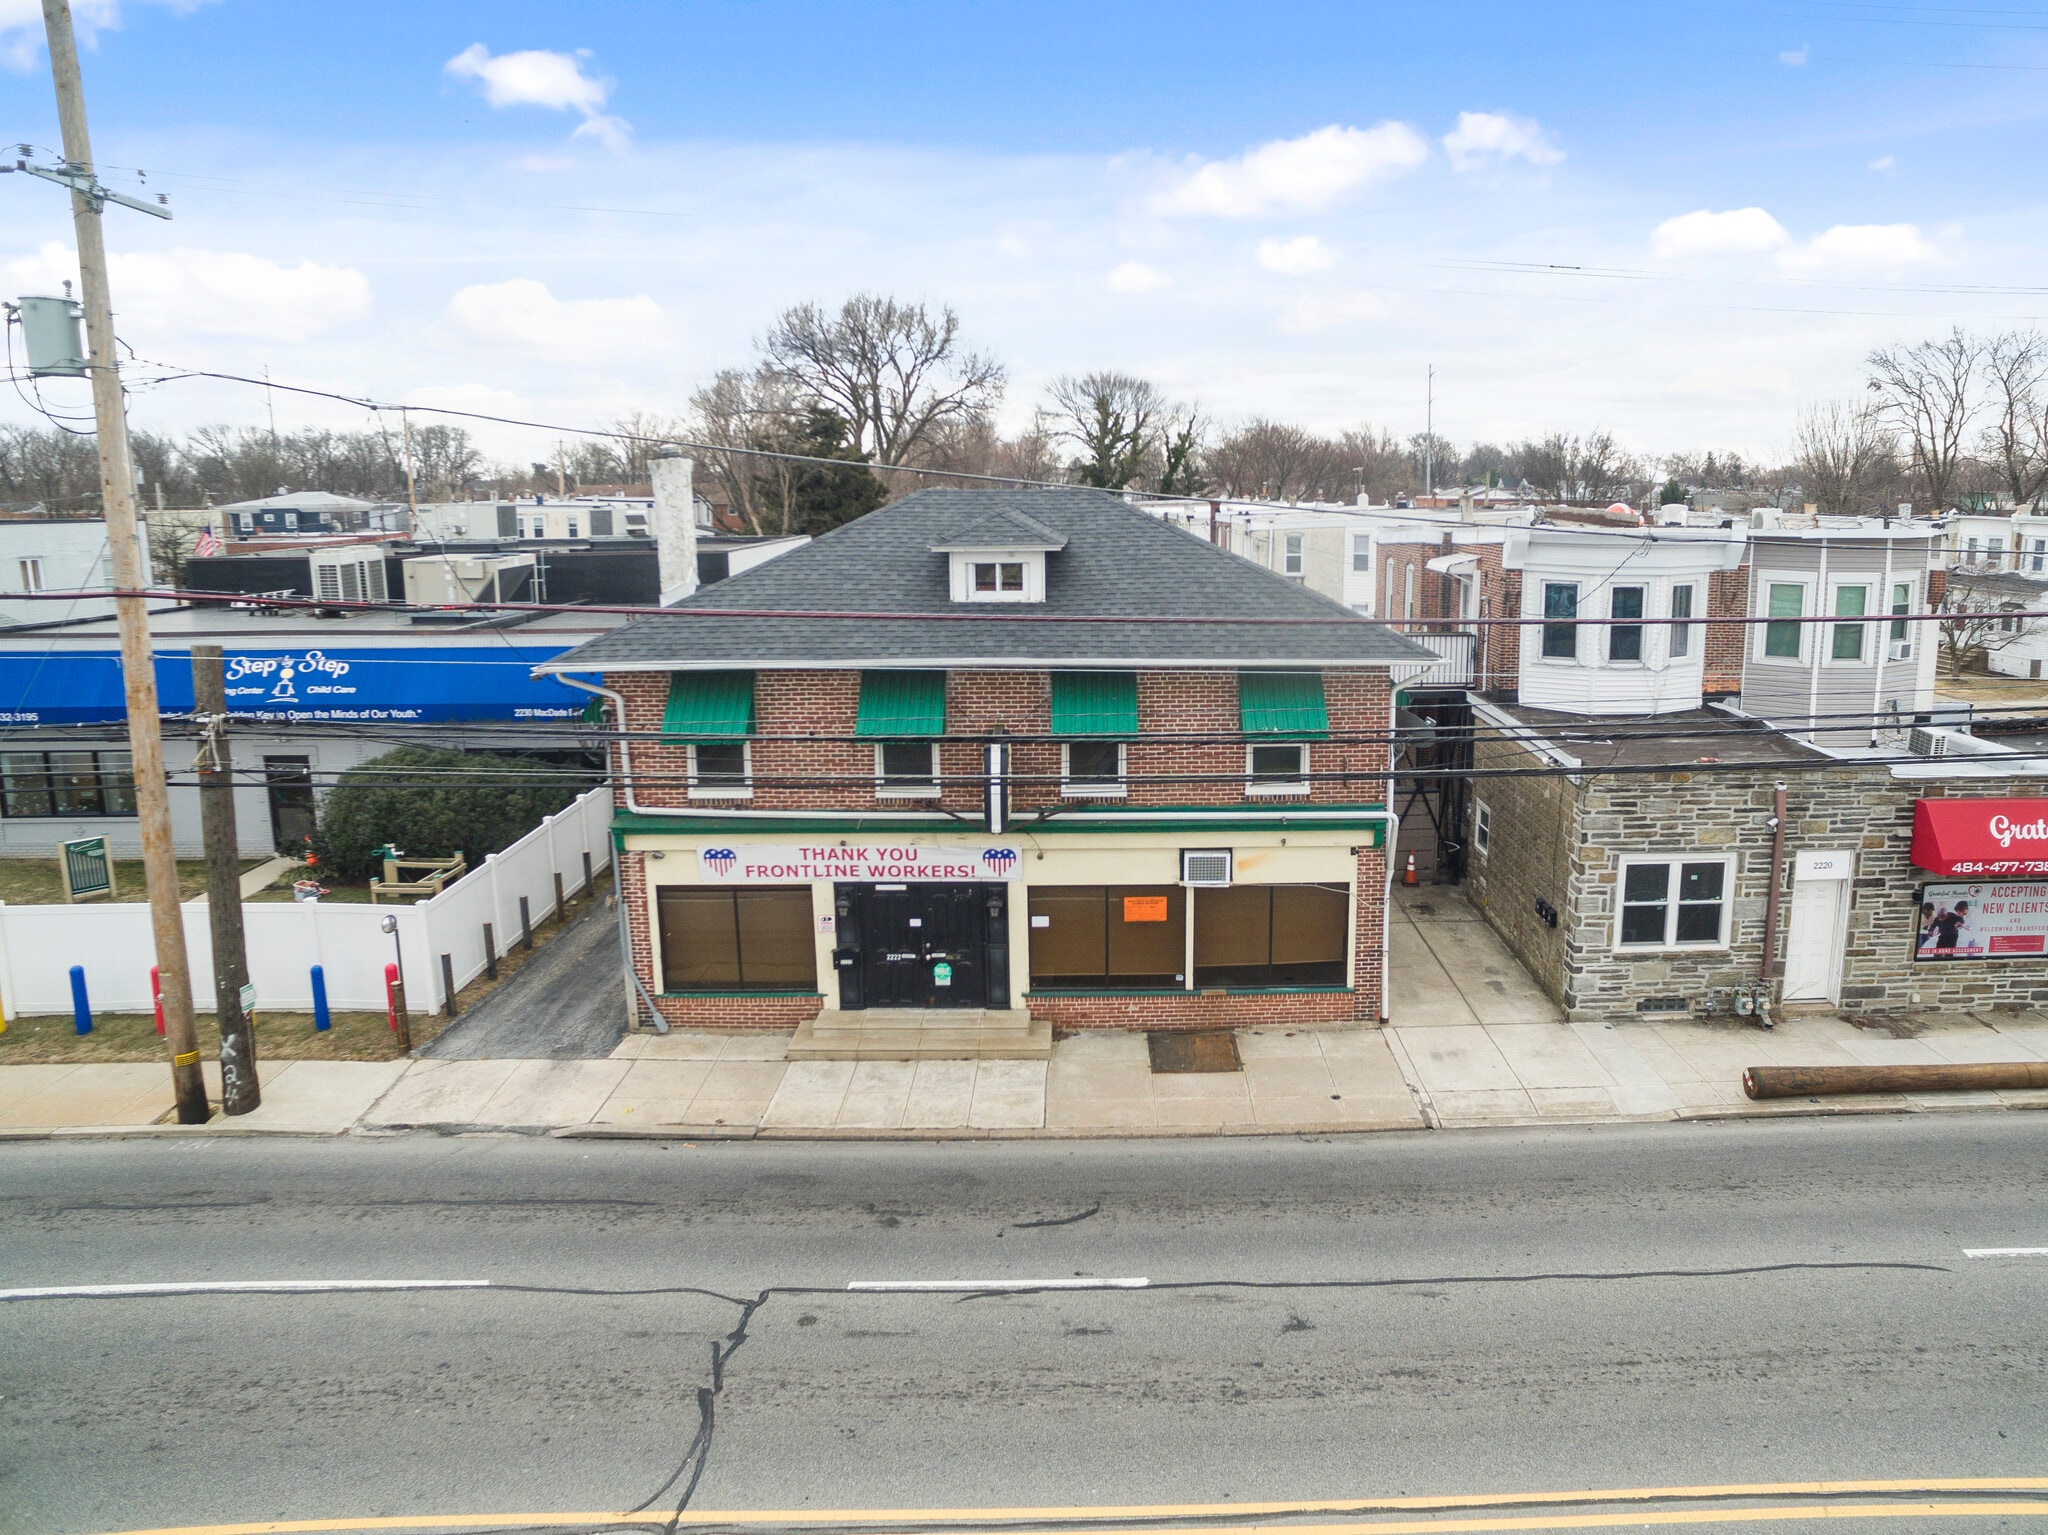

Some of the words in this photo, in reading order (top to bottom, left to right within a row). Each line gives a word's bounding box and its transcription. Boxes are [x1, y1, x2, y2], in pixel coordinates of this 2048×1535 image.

[226, 657, 277, 680] Step
[298, 651, 350, 678] Step
[306, 686, 331, 694] Child
[332, 686, 357, 694] Care
[0, 713, 39, 722] 32-3195
[256, 711, 274, 720] Key
[287, 710, 313, 720] Open
[314, 710, 330, 719] the
[331, 710, 358, 719] Minds
[359, 709, 370, 719] of
[371, 709, 389, 719] Our
[1989, 815, 2048, 848] Grat
[800, 848, 868, 861] THANK
[876, 848, 918, 861] YOU
[745, 864, 860, 878] FRONTLINE
[867, 865, 976, 878] WORKERS!
[1813, 861, 1833, 870] 2220
[1990, 885, 2047, 898] ACCEPTING
[1982, 902, 2005, 914] NEW
